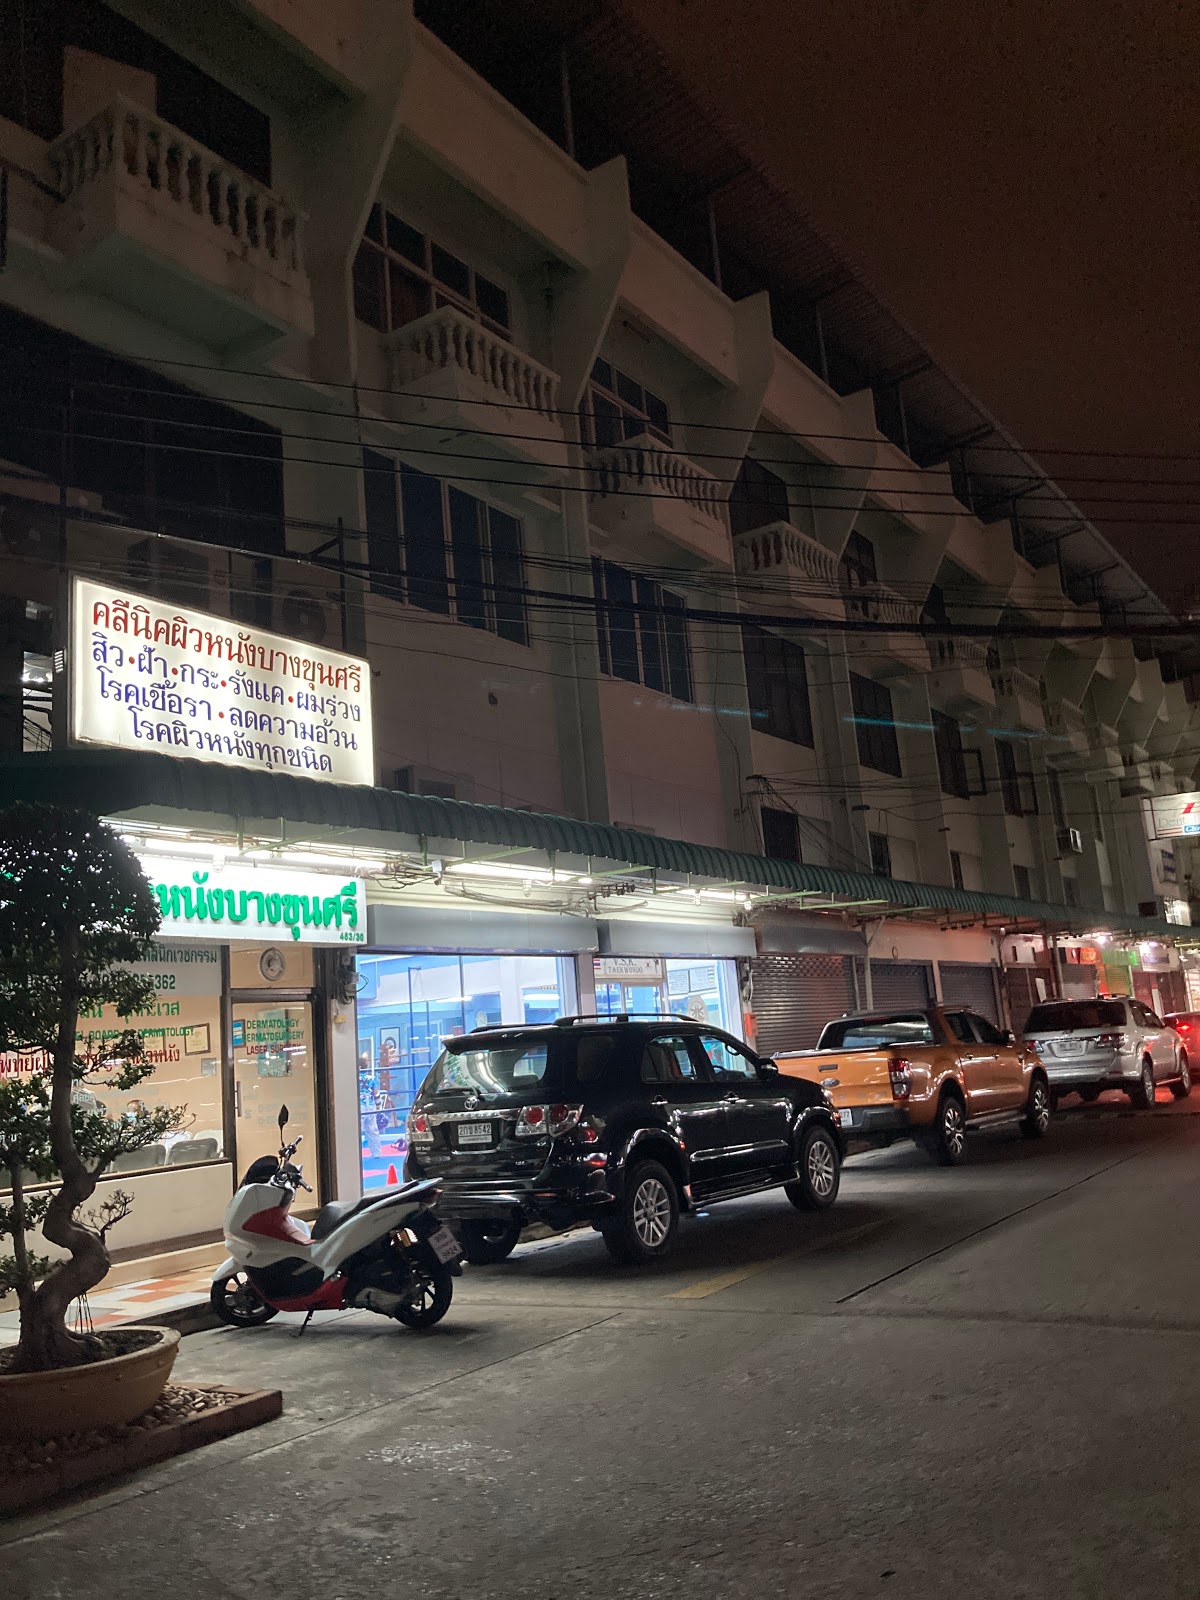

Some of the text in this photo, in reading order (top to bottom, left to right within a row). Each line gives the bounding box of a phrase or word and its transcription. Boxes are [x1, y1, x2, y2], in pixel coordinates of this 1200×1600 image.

[92, 631, 124, 667] สิว
[180, 663, 219, 690] กระ
[93, 598, 361, 693] คลีนิคผิวหนังบางขุนศรี
[229, 706, 358, 751] ลดความอ้วน
[247, 1018, 299, 1029] DERMATOLOGY
